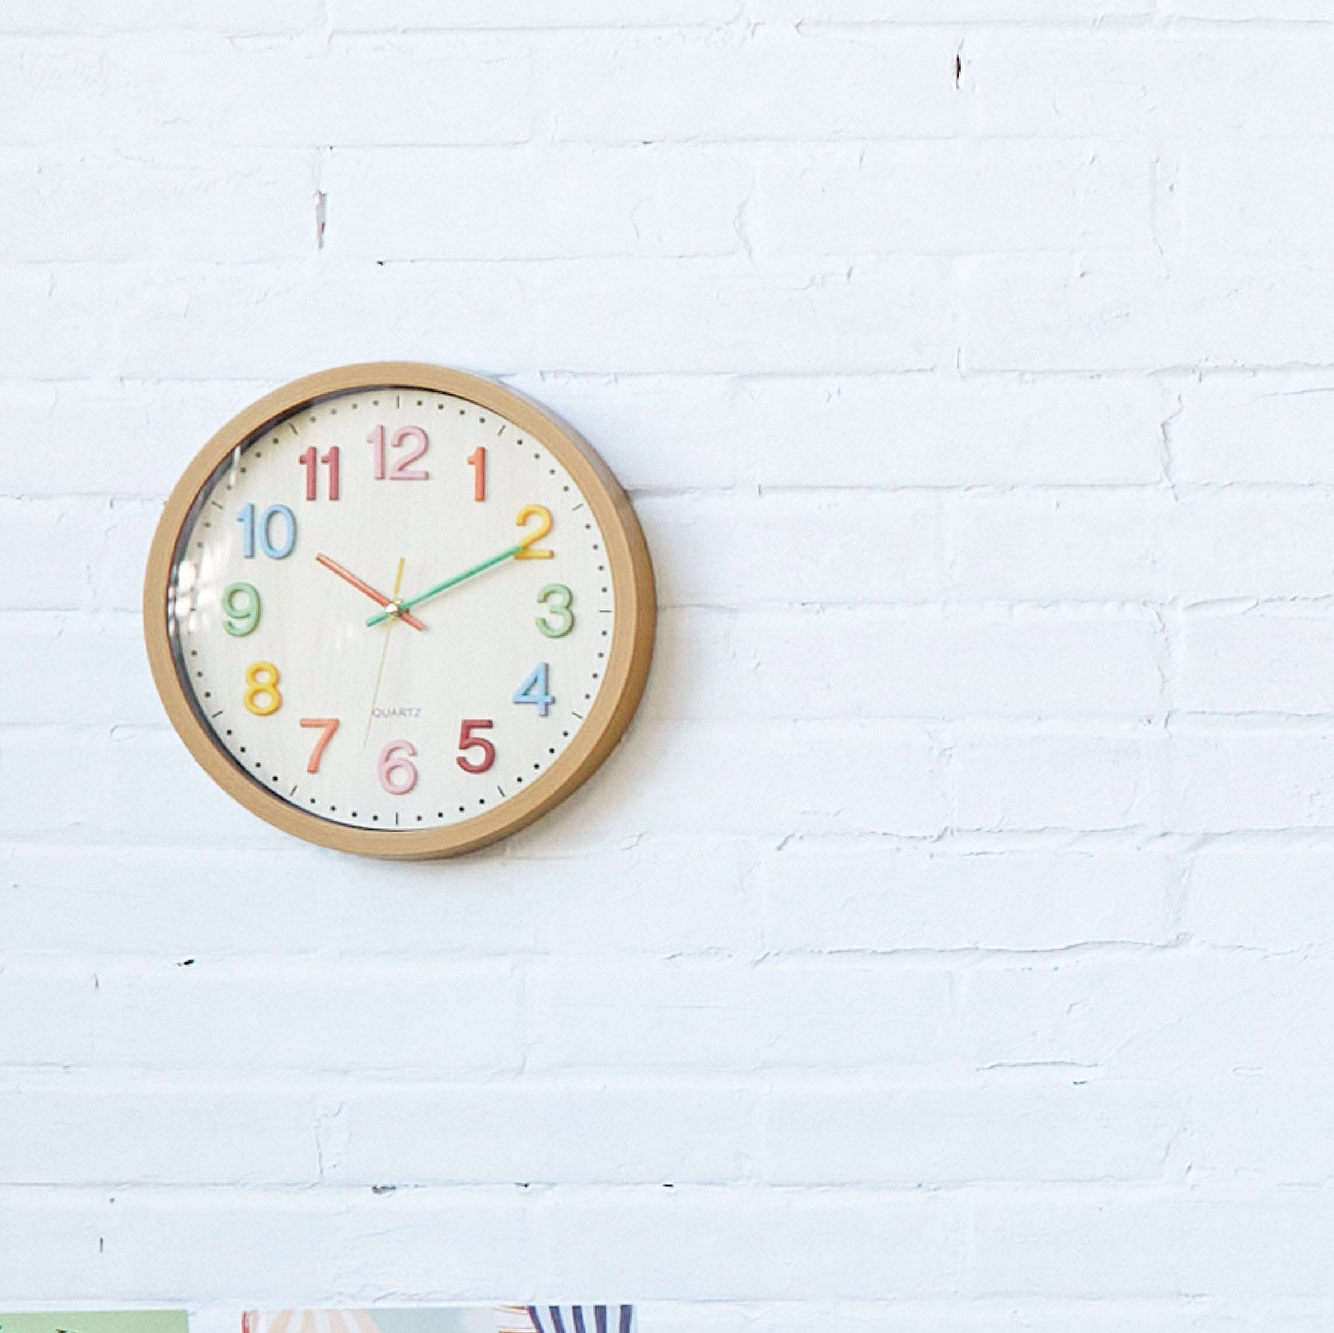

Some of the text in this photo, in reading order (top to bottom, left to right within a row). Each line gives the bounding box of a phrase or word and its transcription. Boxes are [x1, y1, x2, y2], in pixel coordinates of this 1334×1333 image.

[298, 446, 340, 501] 11
[367, 424, 429, 481] 12
[467, 446, 486, 502] 1
[236, 503, 297, 559] 10
[514, 504, 555, 560] 2
[222, 581, 262, 637] 9
[535, 583, 575, 638] 3
[243, 661, 283, 717] 8
[512, 662, 556, 717] 4
[299, 719, 340, 773] 7
[377, 740, 418, 795] 6
[456, 719, 496, 773] 5
